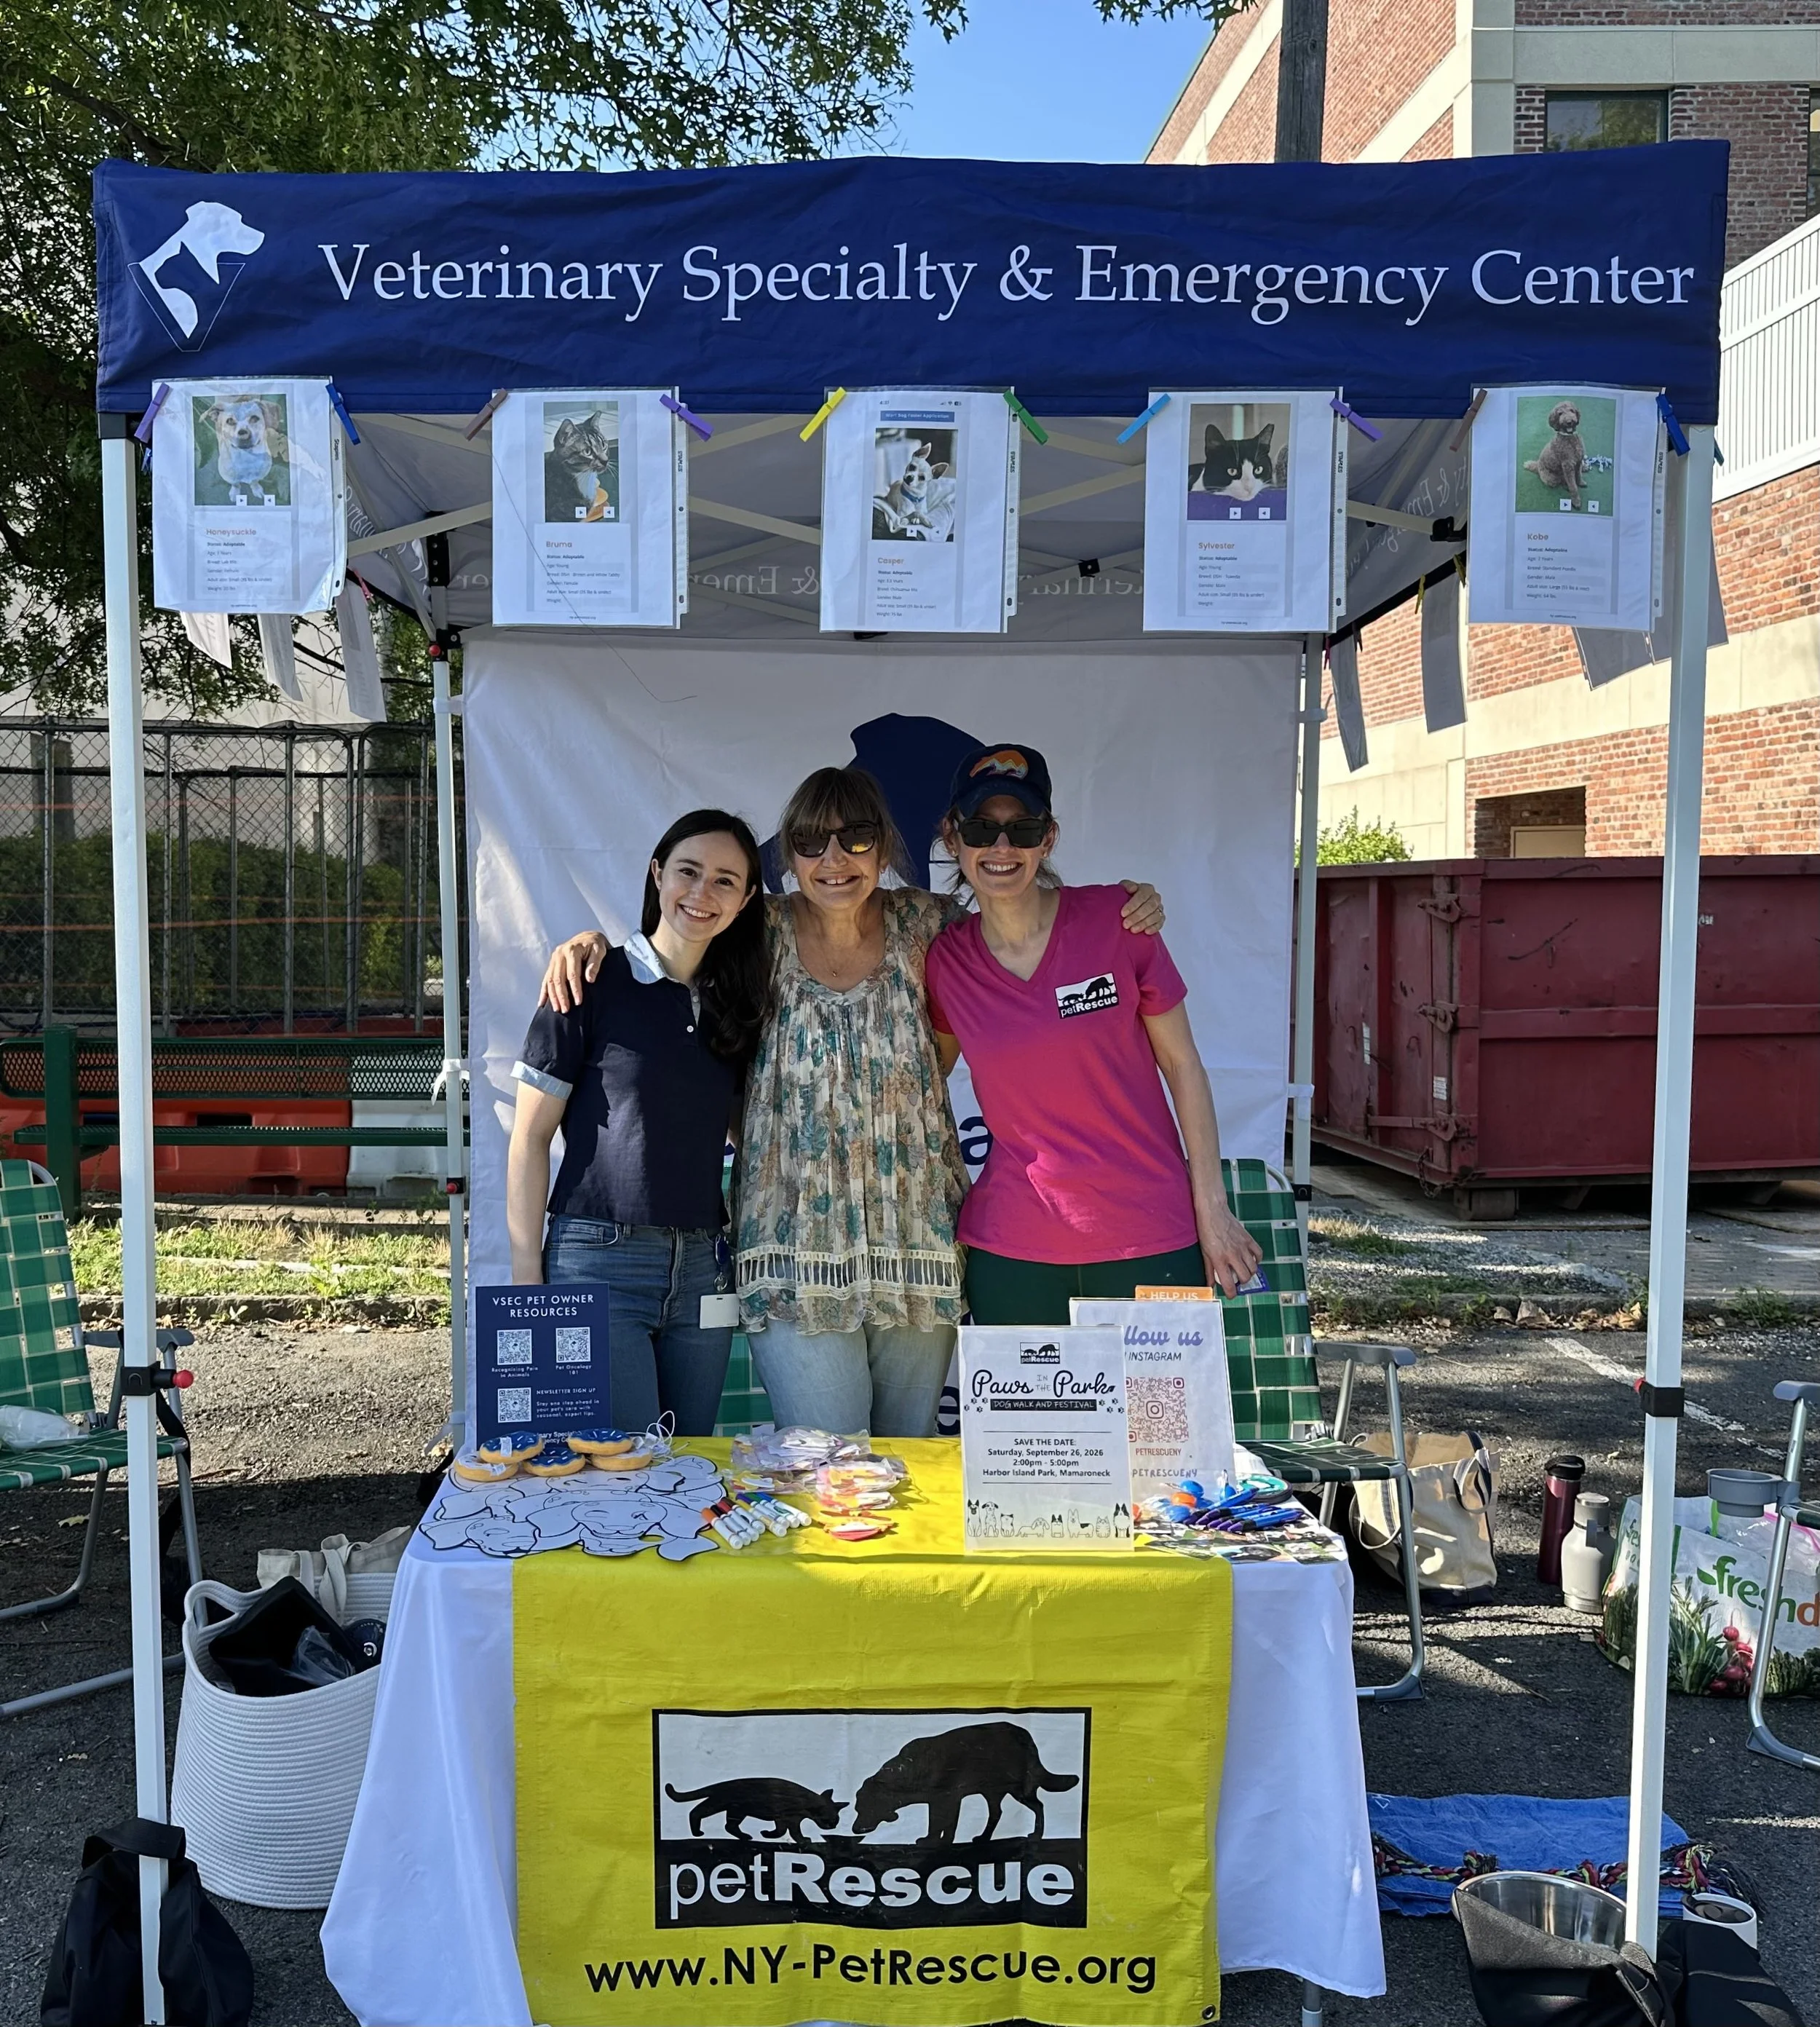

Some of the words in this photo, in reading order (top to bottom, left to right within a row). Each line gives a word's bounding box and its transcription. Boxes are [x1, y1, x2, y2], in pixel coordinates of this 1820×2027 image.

[317, 242, 662, 323] Veterinary
[681, 242, 978, 323] Specialty
[1000, 245, 1054, 302] &
[1075, 244, 1449, 327] Emergency
[1471, 248, 1693, 307] Center
[206, 528, 257, 537] Honeysuckle
[1198, 542, 1235, 551] Sylvester
[877, 557, 905, 566] Casper
[1060, 995, 1118, 1019] petRescue
[492, 1296, 523, 1306] VSEC
[526, 1295, 547, 1305] PET
[550, 1294, 595, 1304] OWNER
[1150, 1291, 1179, 1300] HELP
[1182, 1292, 1199, 1300] US
[510, 1306, 578, 1318] RESOURCES
[1177, 1330, 1203, 1346] us
[1128, 1351, 1182, 1362] INSTAGRAM
[972, 1369, 1034, 1398] Paws
[1035, 1383, 1052, 1391] THE
[1053, 1370, 1115, 1398] Park
[993, 1400, 1011, 1409] DOG
[1013, 1400, 1034, 1408] WALK
[1035, 1400, 1053, 1408] AND
[1054, 1400, 1094, 1408] FESTIVAL
[988, 1449, 1024, 1458] Saturday,
[1026, 1449, 1068, 1458] September
[1070, 1449, 1083, 1458] 26,
[1135, 1447, 1182, 1456] PETRESCUENY
[1013, 1459, 1042, 1467] 2:00pm
[1050, 1459, 1080, 1467] 5:00pm
[983, 1469, 1010, 1477] Harbor
[1013, 1469, 1035, 1477] Island
[1037, 1469, 1058, 1477] Park,
[1060, 1469, 1110, 1477] Mamaroneck
[1132, 1469, 1198, 1478] PETRESCUENY
[669, 1852, 1075, 1921] petRescue
[585, 1943, 1157, 1994] www.NY-PetRescue.org
